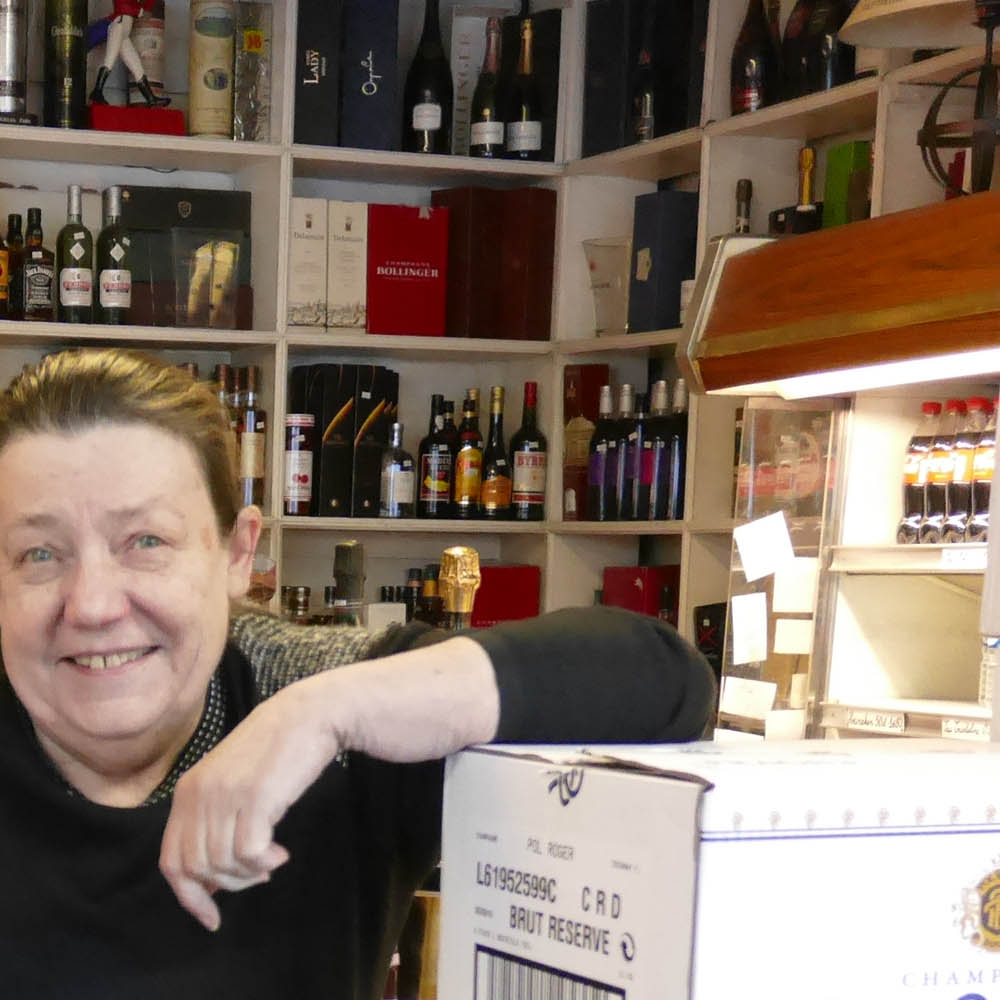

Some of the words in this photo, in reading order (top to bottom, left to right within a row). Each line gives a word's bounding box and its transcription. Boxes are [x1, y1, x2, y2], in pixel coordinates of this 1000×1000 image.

[303, 50, 320, 85] LADY
[376, 266, 439, 278] BOLLINGER
[475, 861, 557, 903] L61952599C
[509, 905, 544, 937] BRUT
[548, 915, 610, 956] RESERVE
